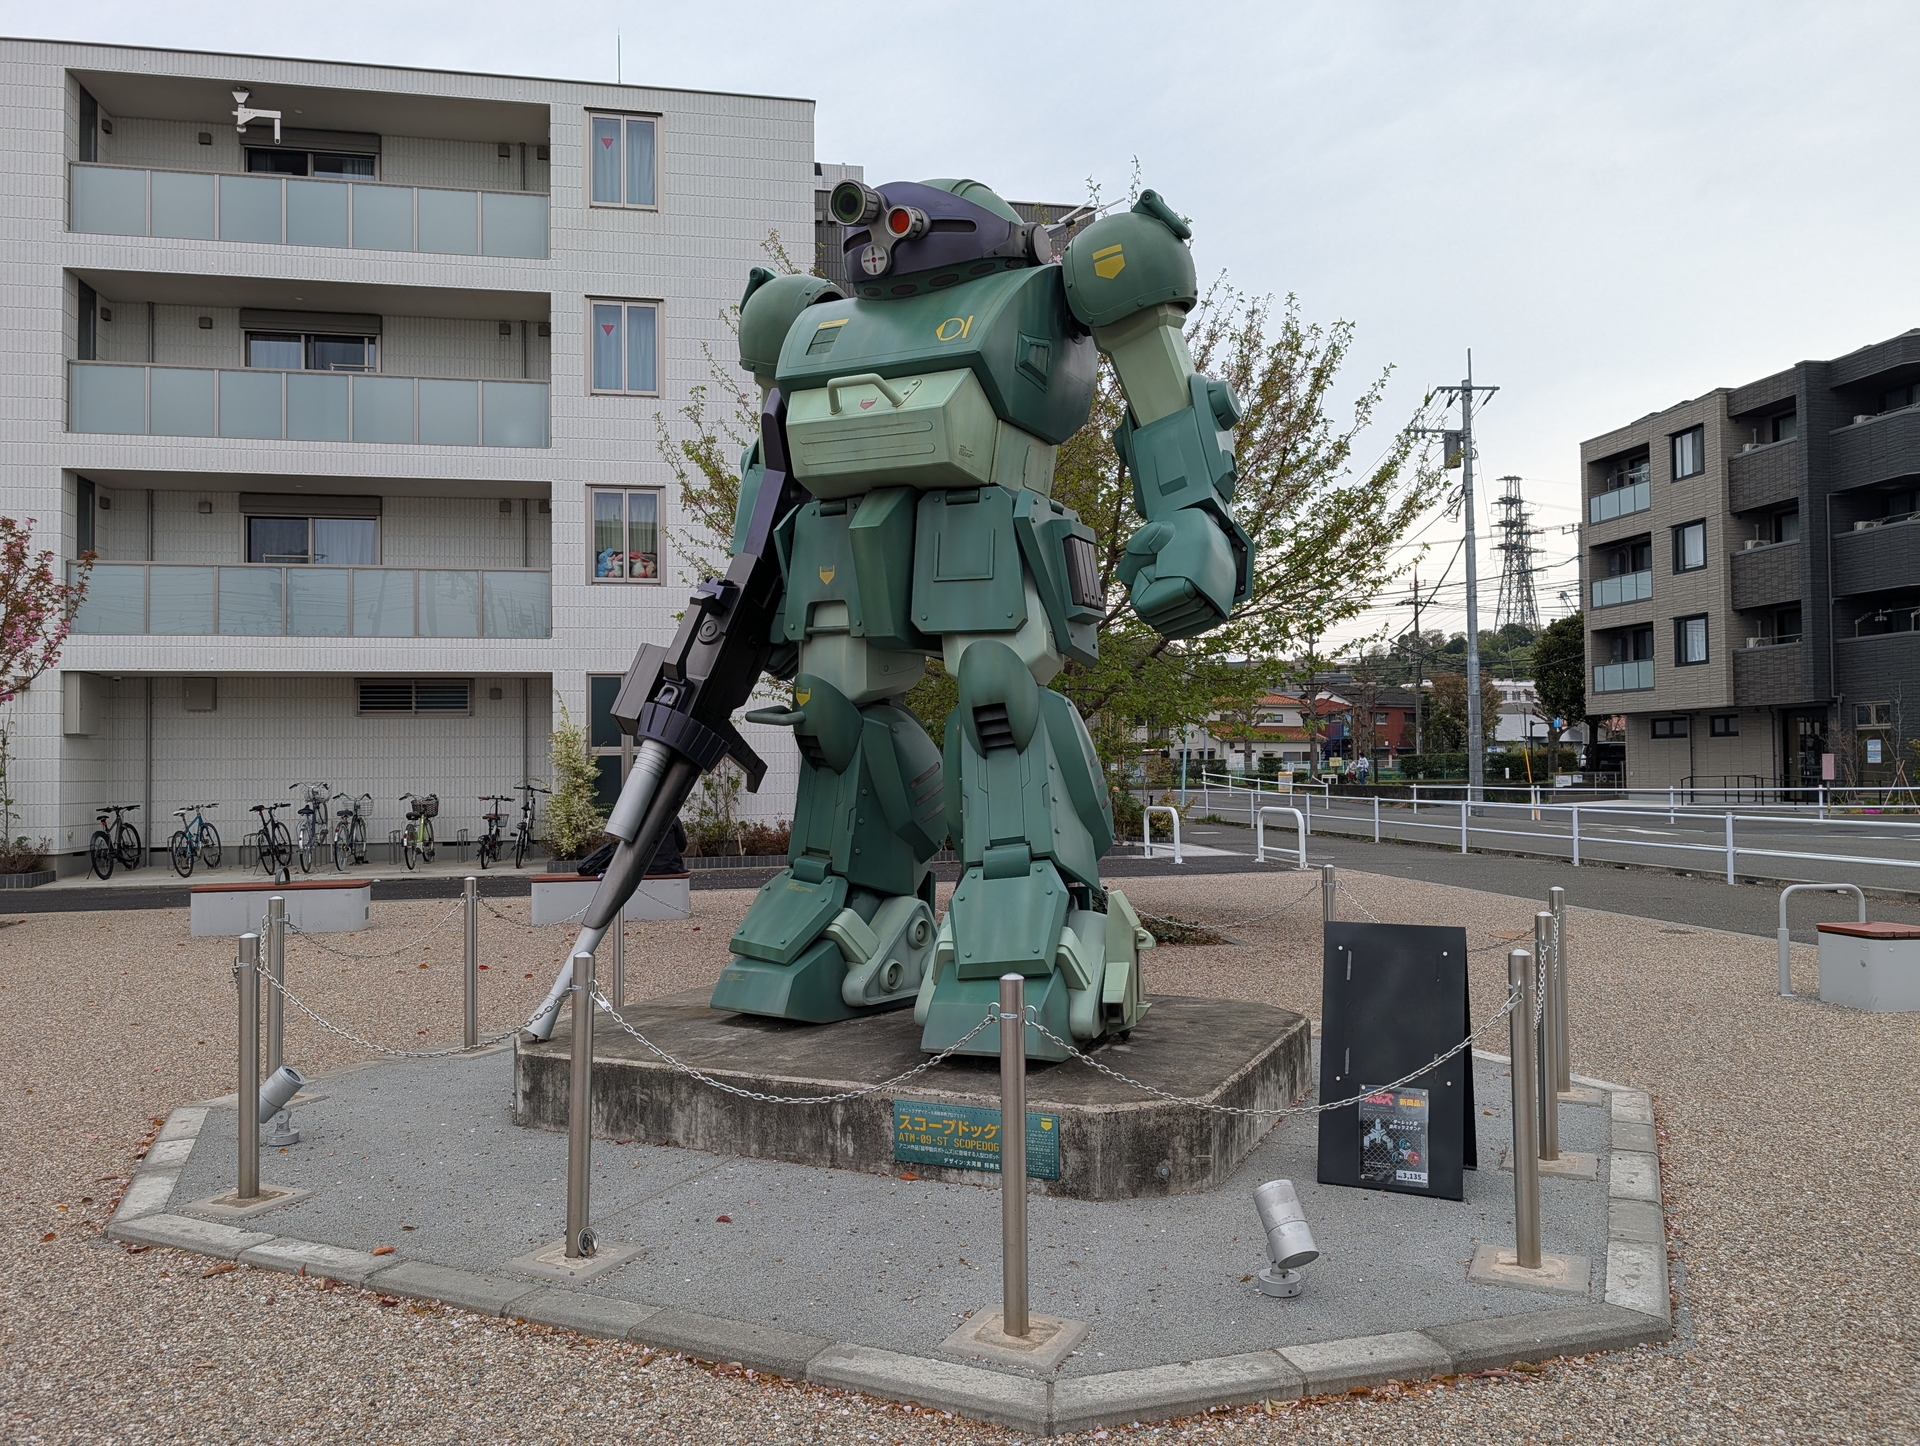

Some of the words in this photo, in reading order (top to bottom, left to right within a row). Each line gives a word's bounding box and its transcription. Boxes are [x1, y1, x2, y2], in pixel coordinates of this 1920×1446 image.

[898, 1114, 1000, 1140] スコープドッグ
[898, 1132, 948, 1147] ATM-09-ST
[953, 1138, 1000, 1152] SCOPEDOG
